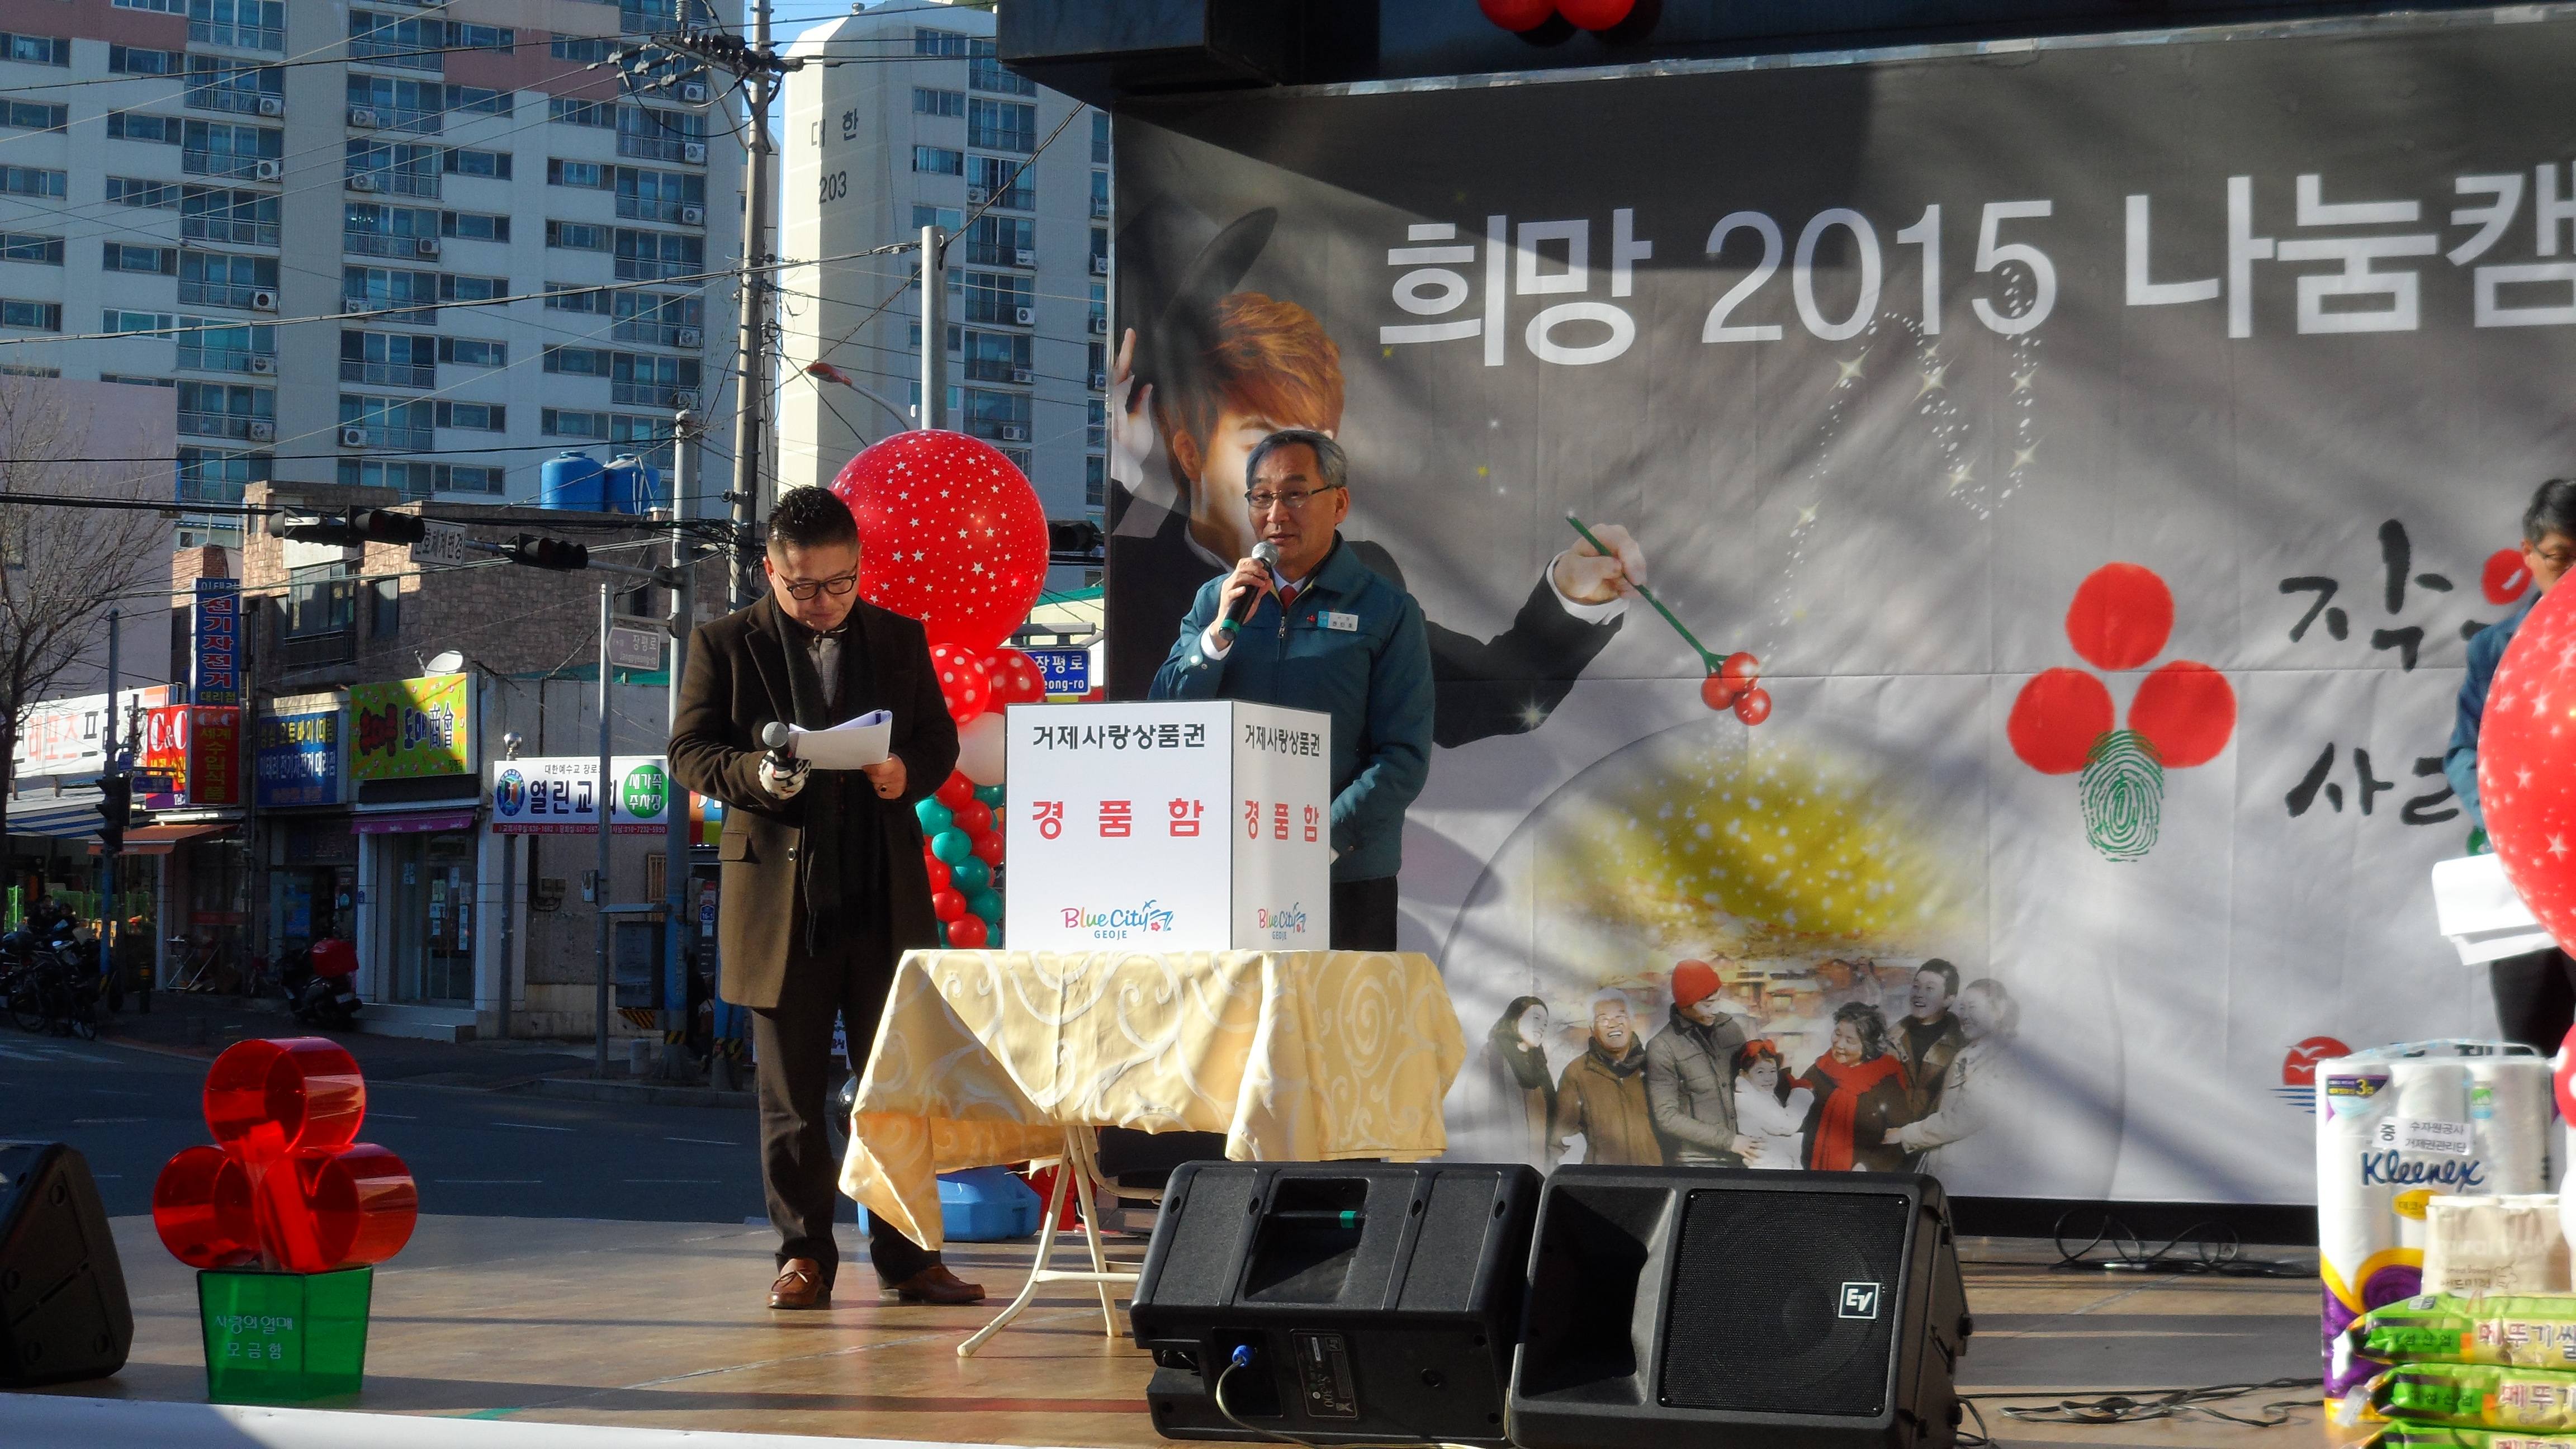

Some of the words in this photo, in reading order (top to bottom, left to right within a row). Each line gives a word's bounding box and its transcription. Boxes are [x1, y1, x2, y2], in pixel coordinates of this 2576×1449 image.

[842, 108, 858, 141] 한
[819, 171, 847, 203] 203
[1380, 208, 1652, 367] 희망
[1702, 200, 2056, 343] 2015
[2278, 519, 2489, 672] 작
[202, 598, 234, 688] 전기자전거
[1035, 655, 1084, 674] 장평로
[1044, 680, 1084, 691] eong-ro
[200, 690, 235, 703] 대리점
[1033, 723, 1205, 750] 거제사랑상품권
[1245, 724, 1320, 756] 거제사랑상품권
[545, 764, 580, 774] 대한예수교
[629, 773, 662, 790] 새가족
[628, 794, 662, 811] 주차장
[1094, 930, 1128, 940] GEOJE
[2410, 1122, 2464, 1135] 수자원공사
[2405, 1138, 2467, 1153] 거제권관리단
[2361, 1149, 2485, 1192] Kleenex
[1846, 1288, 1873, 1312] EV
